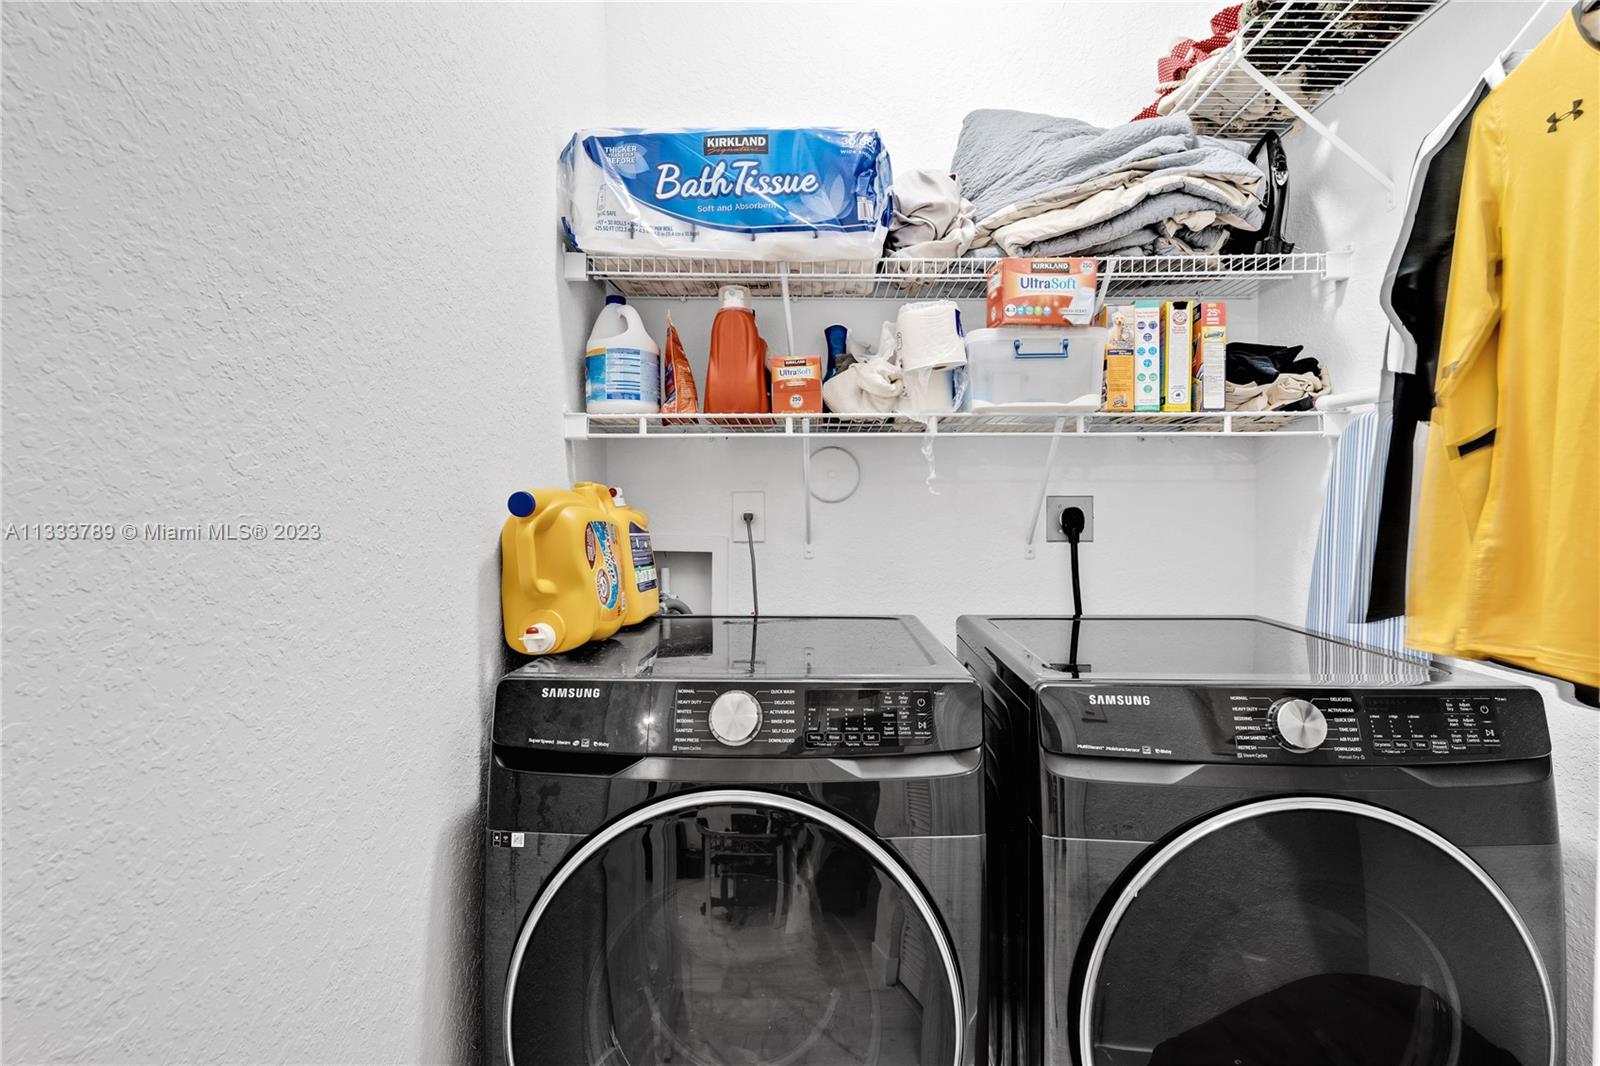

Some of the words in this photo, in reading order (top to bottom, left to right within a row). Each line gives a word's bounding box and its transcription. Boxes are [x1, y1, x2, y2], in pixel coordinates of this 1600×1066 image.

[707, 136, 766, 148] KIRKLAND
[656, 161, 733, 200] Bath
[731, 160, 819, 196] Tissue
[697, 203, 714, 212] Soft
[716, 203, 732, 212] and
[1032, 262, 1069, 270] KIRKLAND
[1020, 277, 1076, 289] UltraSoft
[779, 368, 811, 376] UltraSoft
[541, 688, 601, 698] SAMSUNG
[1088, 694, 1151, 706] SAMSUNG
